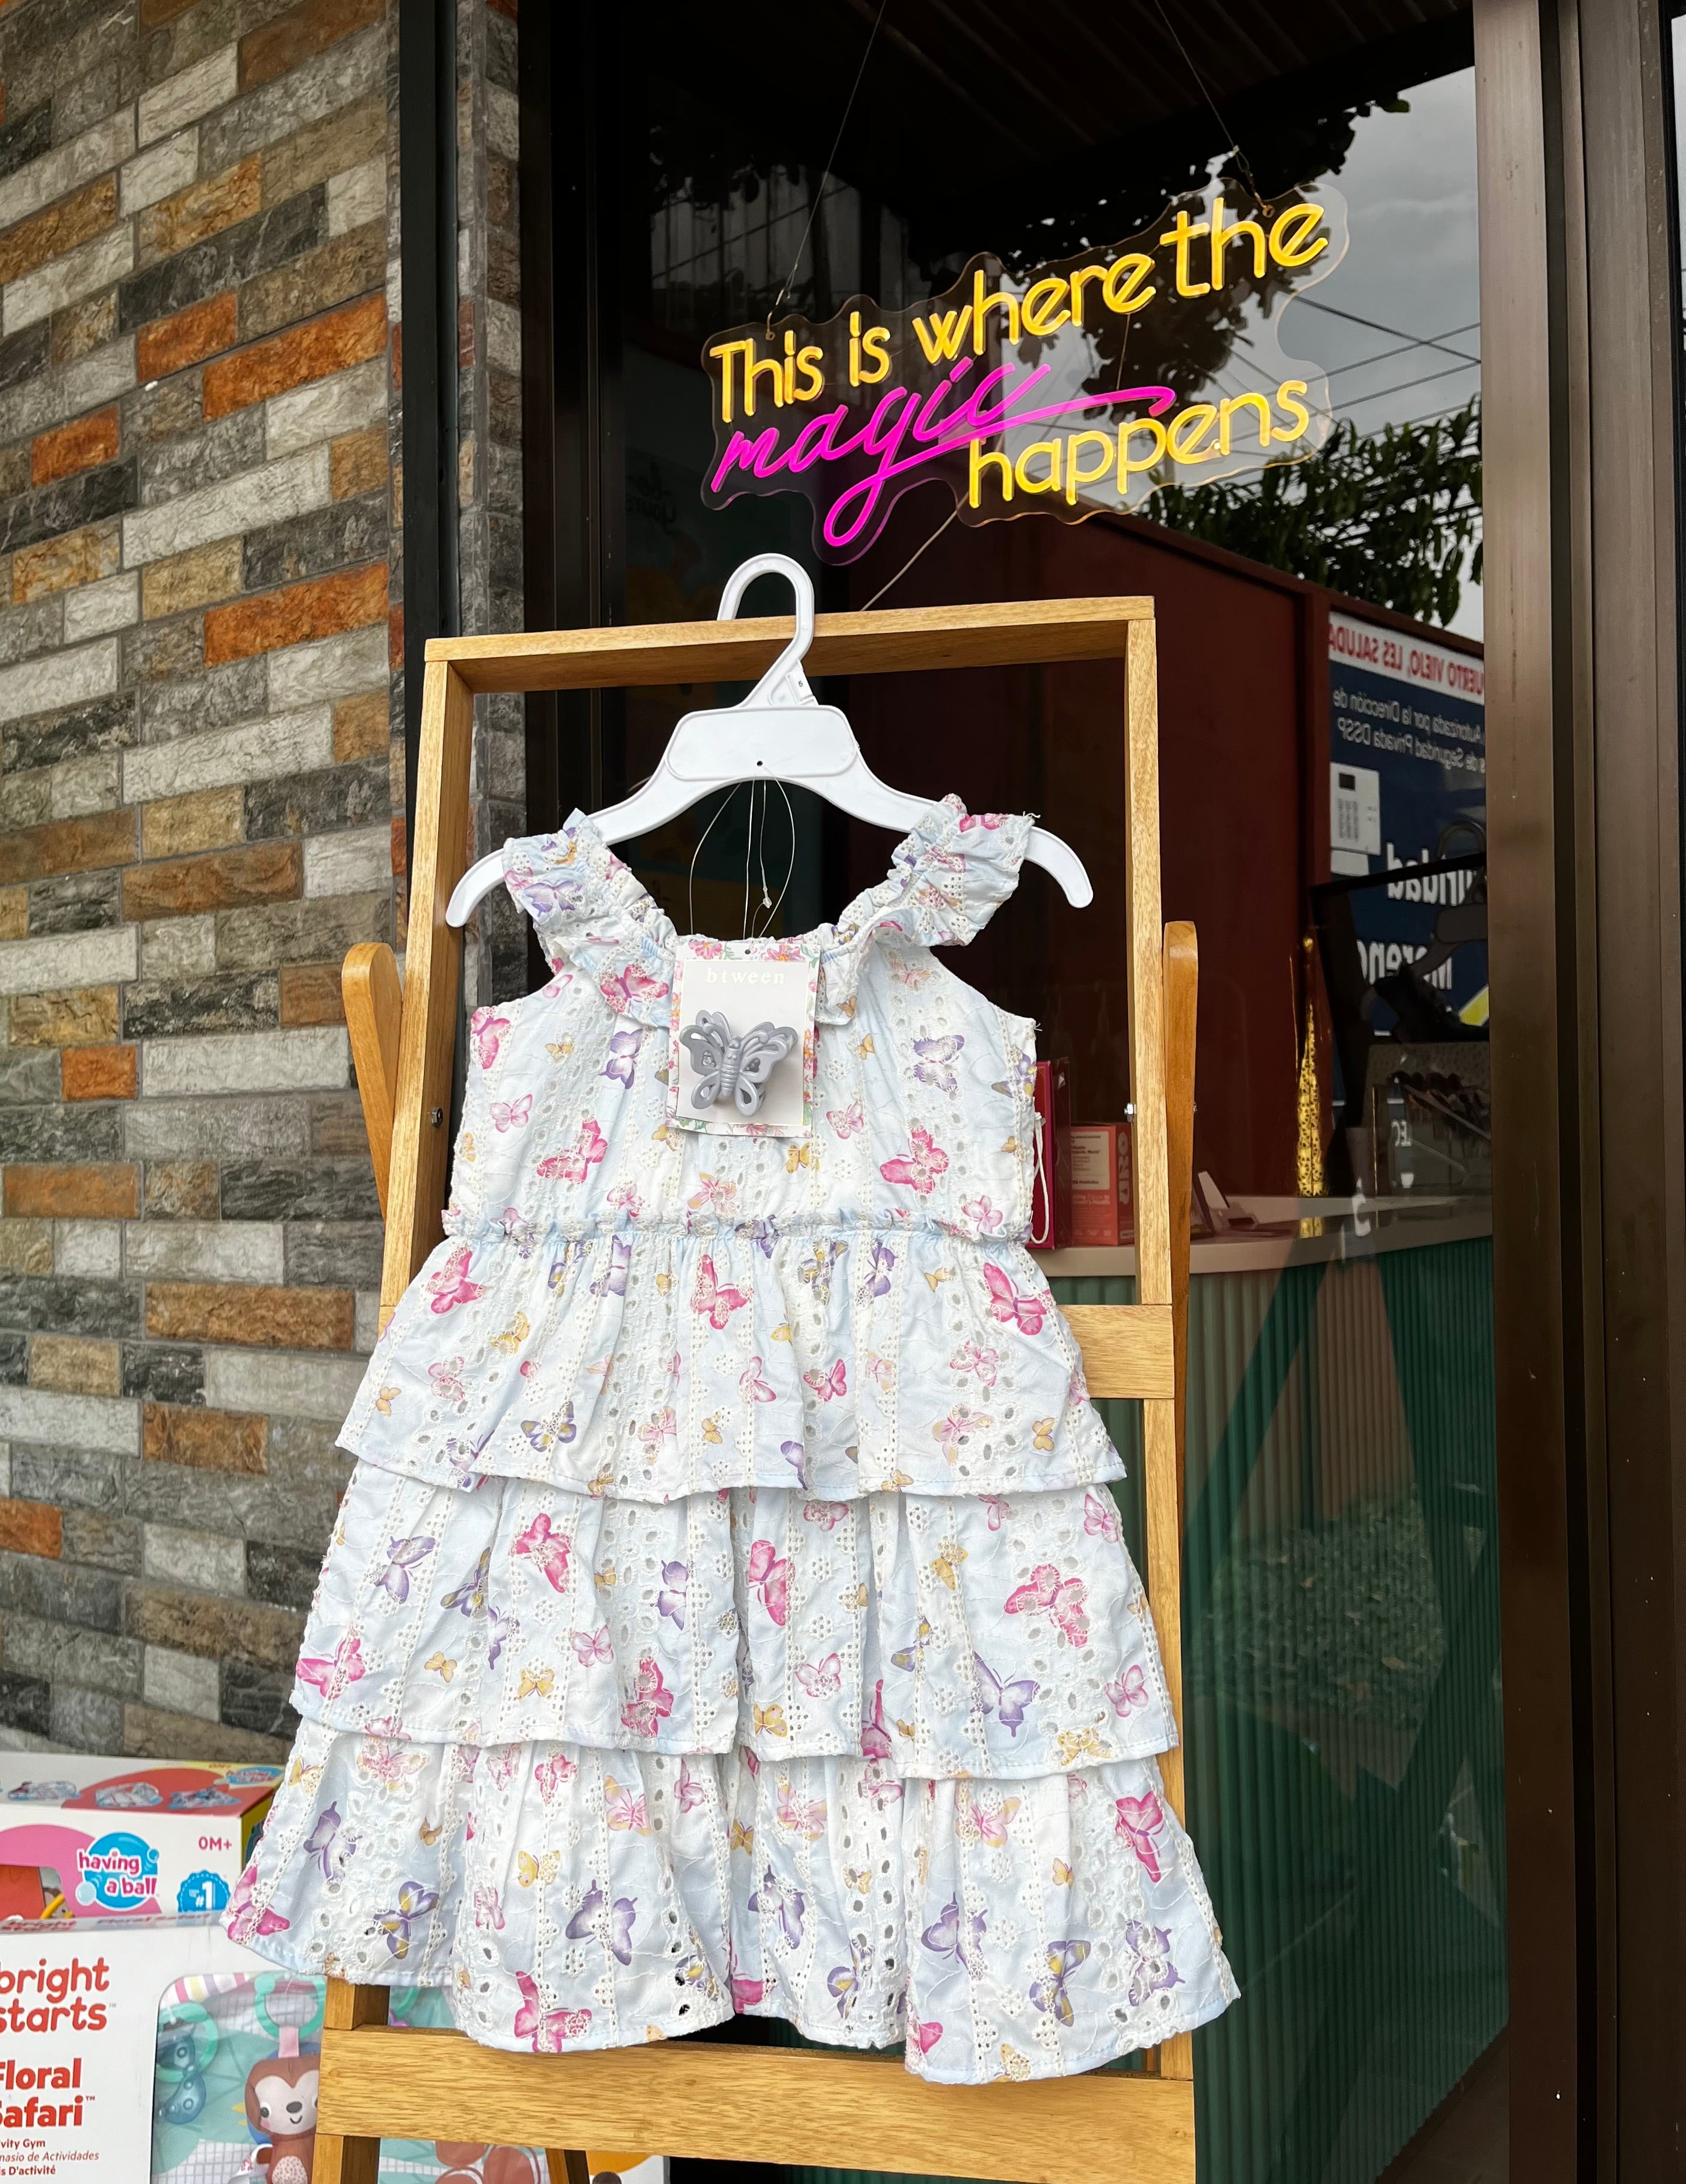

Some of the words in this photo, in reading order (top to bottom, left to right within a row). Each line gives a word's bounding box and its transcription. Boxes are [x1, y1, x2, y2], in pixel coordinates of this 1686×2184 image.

[710, 330, 824, 423] This
[849, 310, 891, 386] is
[913, 269, 1156, 365] where
[1159, 197, 1328, 297] the
[711, 357, 1175, 546] magic
[969, 380, 1309, 509] happens
[706, 967, 785, 985] btween
[78, 1851, 140, 1875] having
[106, 1881, 117, 1894] a
[122, 1878, 157, 1895] ball
[22, 2138, 46, 2151] Gym
[28, 2152, 39, 2162] de
[42, 2150, 99, 2162] Actividades
[8, 2165, 56, 2176] D'activité
